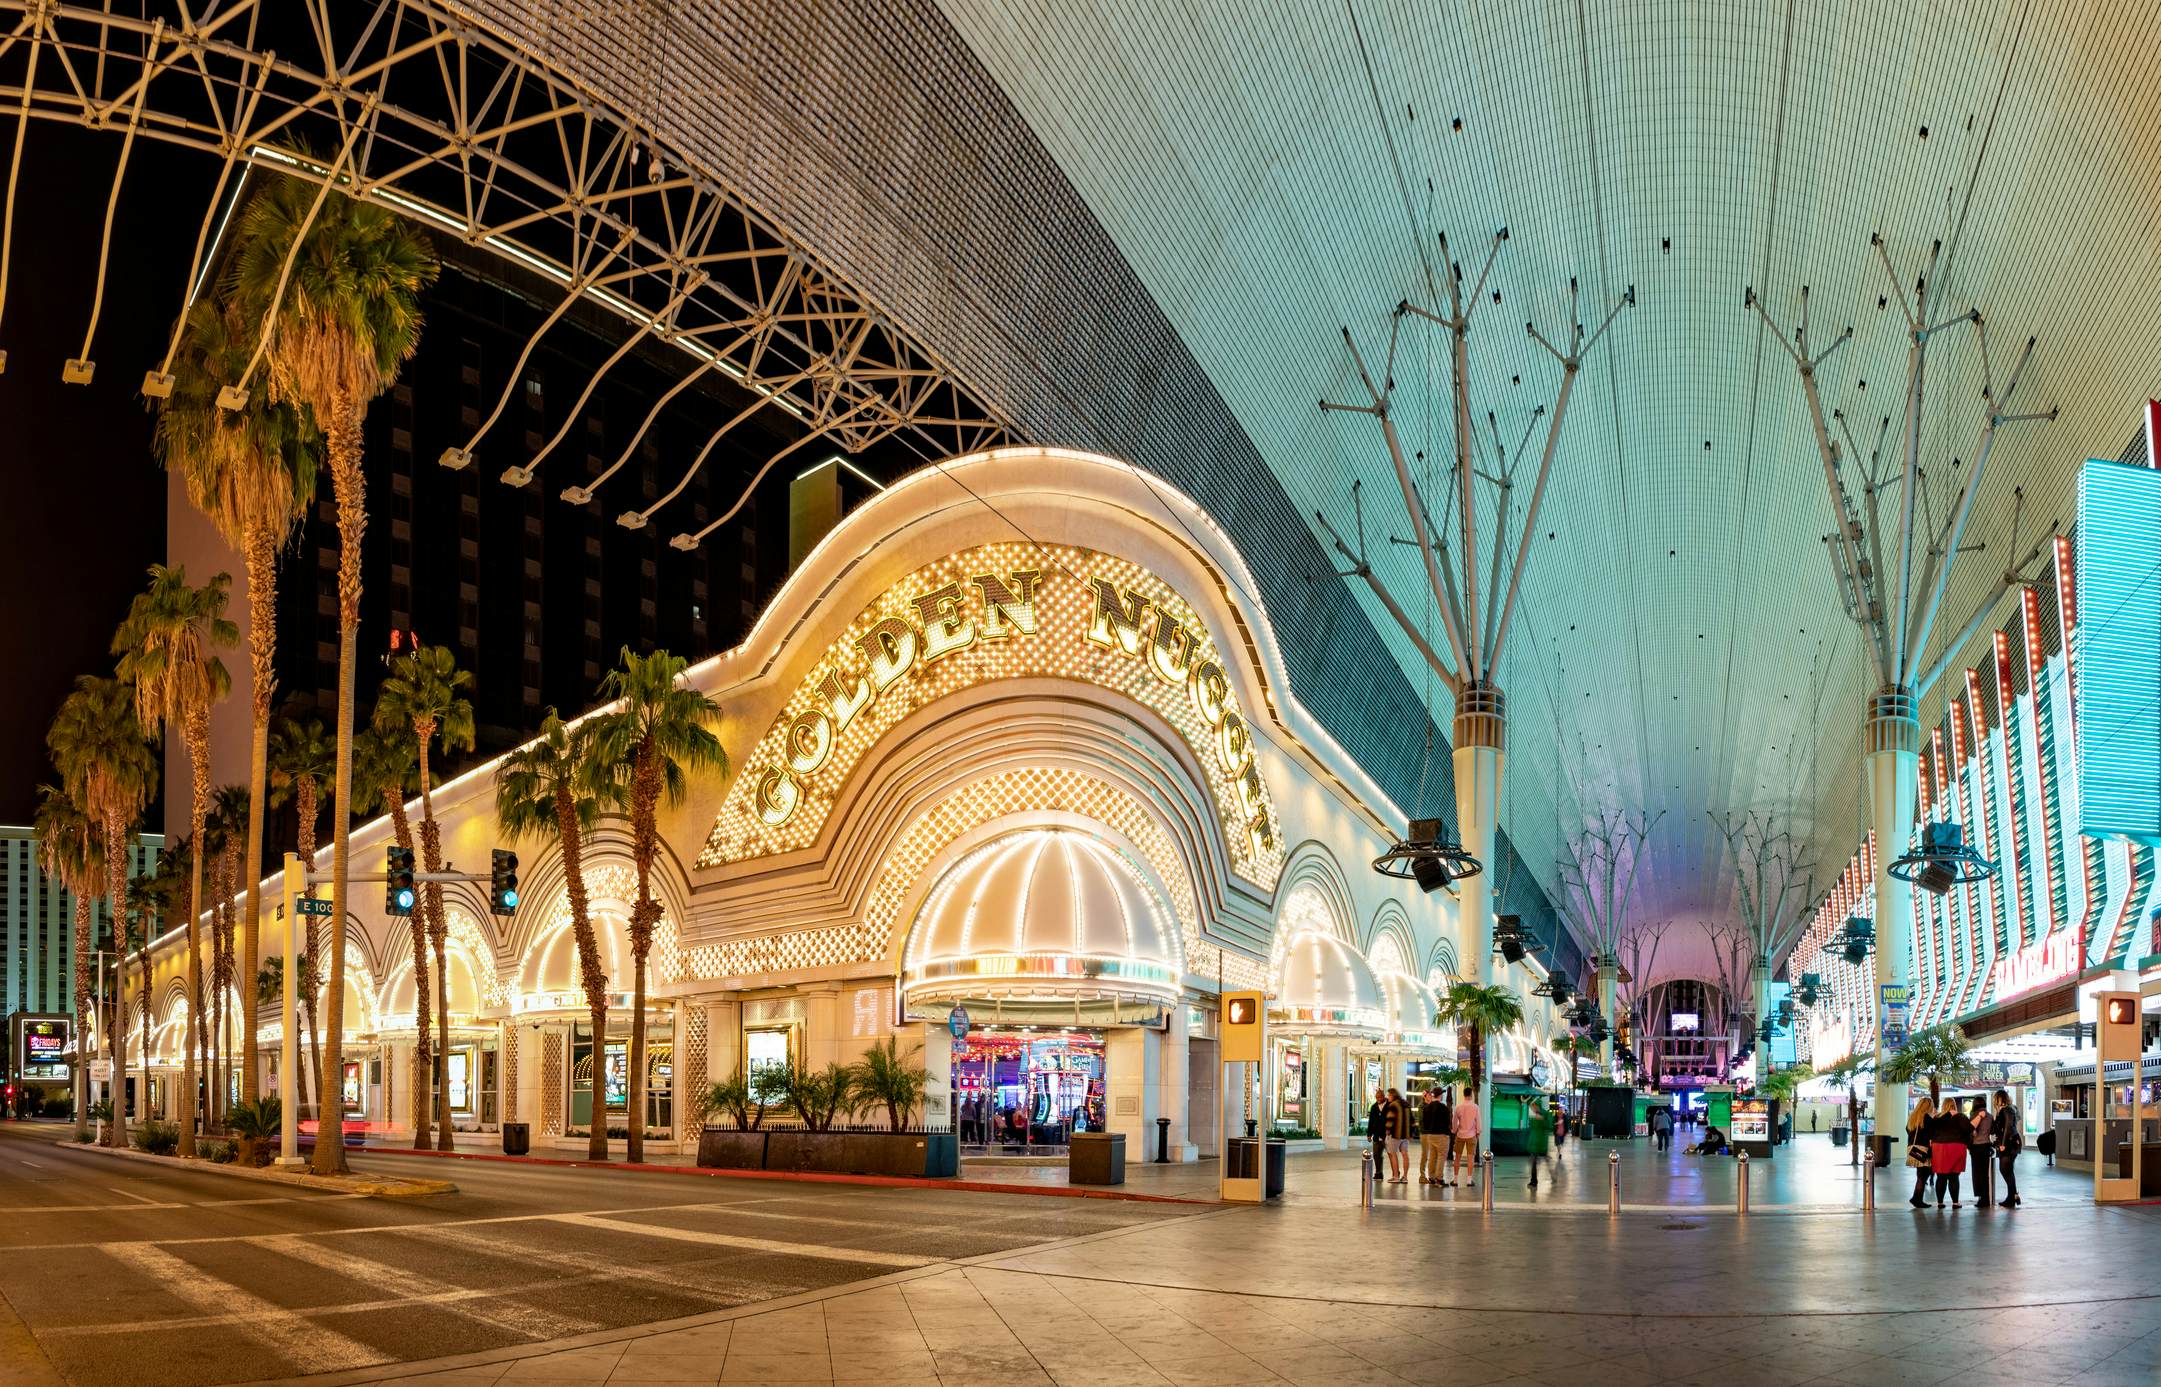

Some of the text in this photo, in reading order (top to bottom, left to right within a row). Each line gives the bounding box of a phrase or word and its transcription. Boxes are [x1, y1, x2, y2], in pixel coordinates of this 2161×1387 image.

[754, 569, 1275, 862] GOLDEN NUGGET
[303, 902, 333, 912] E 100
[1883, 988, 1907, 999] NOW
[1986, 1063, 2001, 1072] LIVE
[1983, 1071, 2004, 1081] POKER
